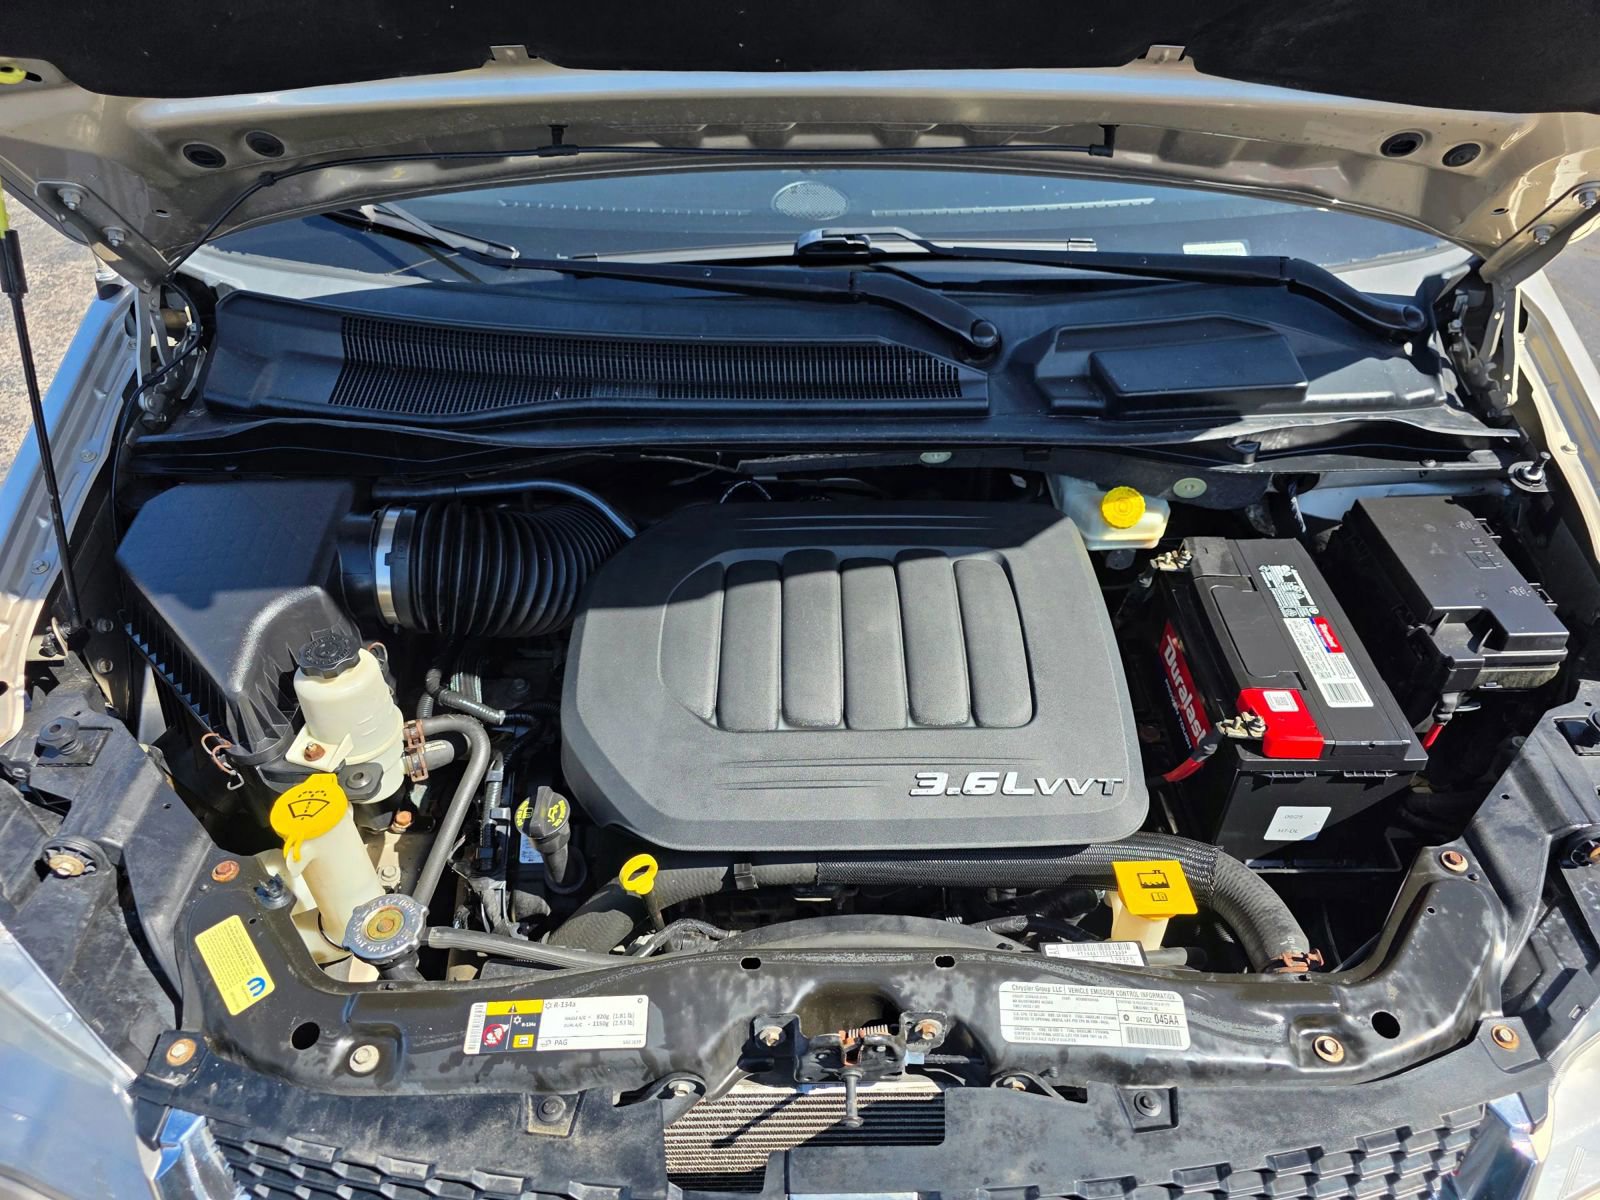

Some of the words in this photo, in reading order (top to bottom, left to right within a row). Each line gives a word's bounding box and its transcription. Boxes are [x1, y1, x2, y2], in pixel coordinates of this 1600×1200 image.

[1164, 635, 1207, 745] Duralast
[1012, 984, 1034, 992] Chrysler
[1068, 987, 1089, 995] VEHICLE
[1140, 992, 1176, 1000] INFORMATION
[1154, 1014, 1179, 1025] 045AA
